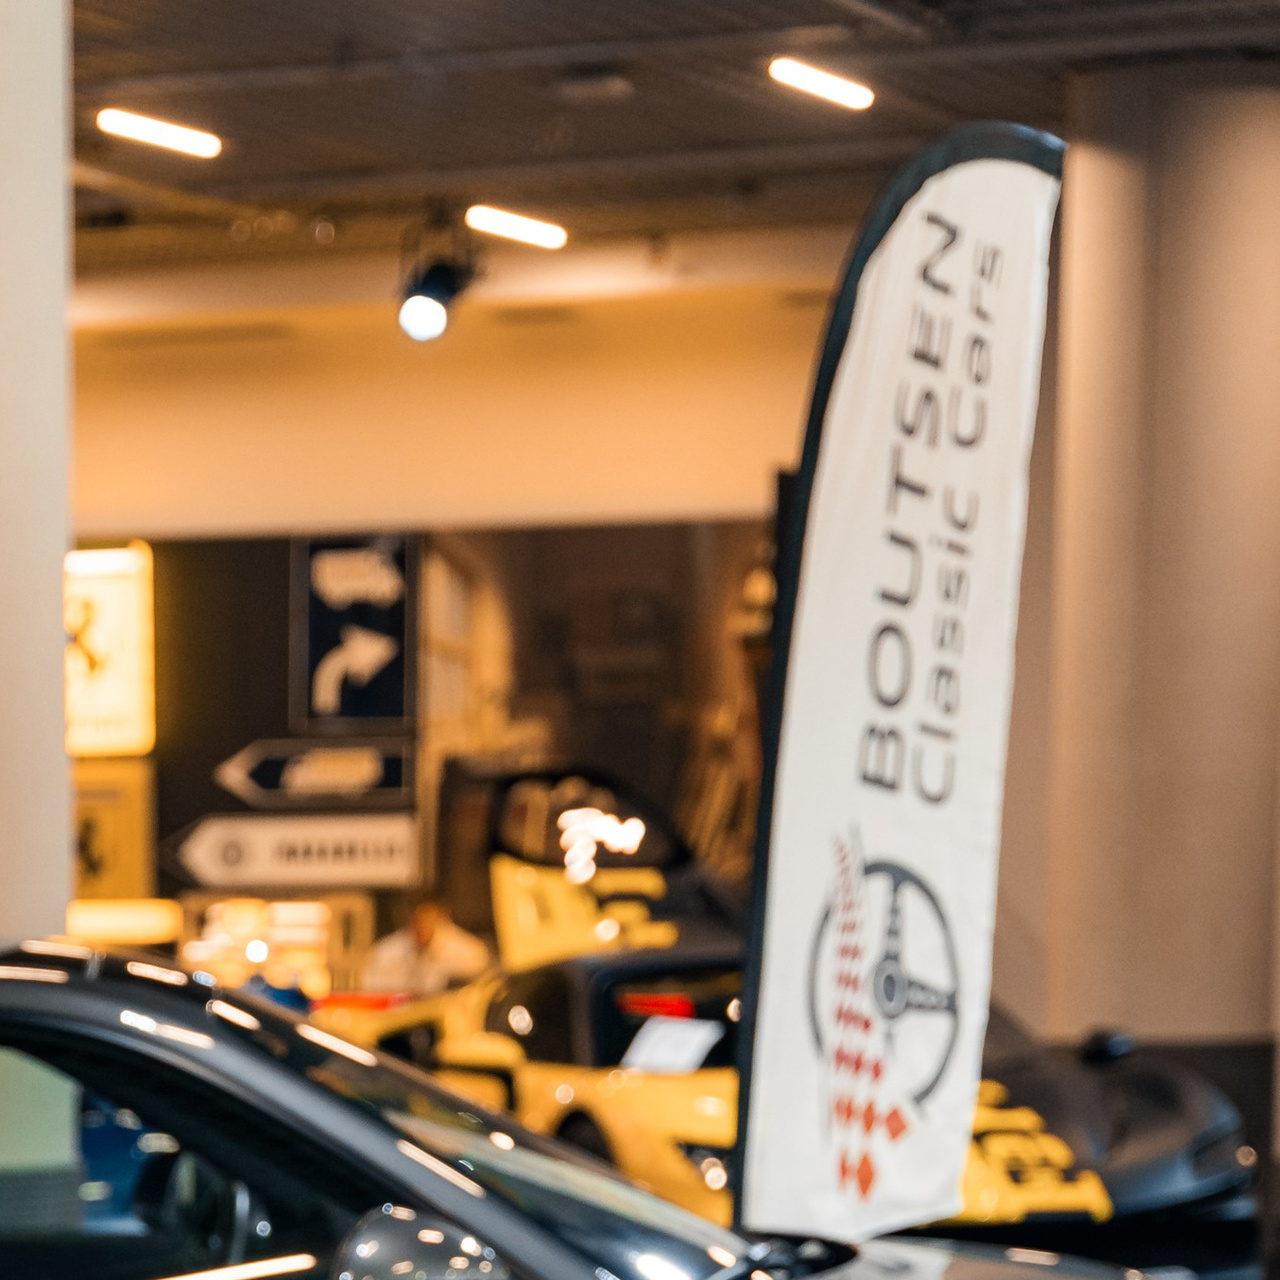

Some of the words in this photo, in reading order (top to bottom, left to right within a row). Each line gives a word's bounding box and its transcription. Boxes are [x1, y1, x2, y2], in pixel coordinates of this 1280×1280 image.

[856, 210, 962, 793] BOUTSEN
[911, 490, 980, 807] Classic
[948, 242, 1004, 448] Cars
